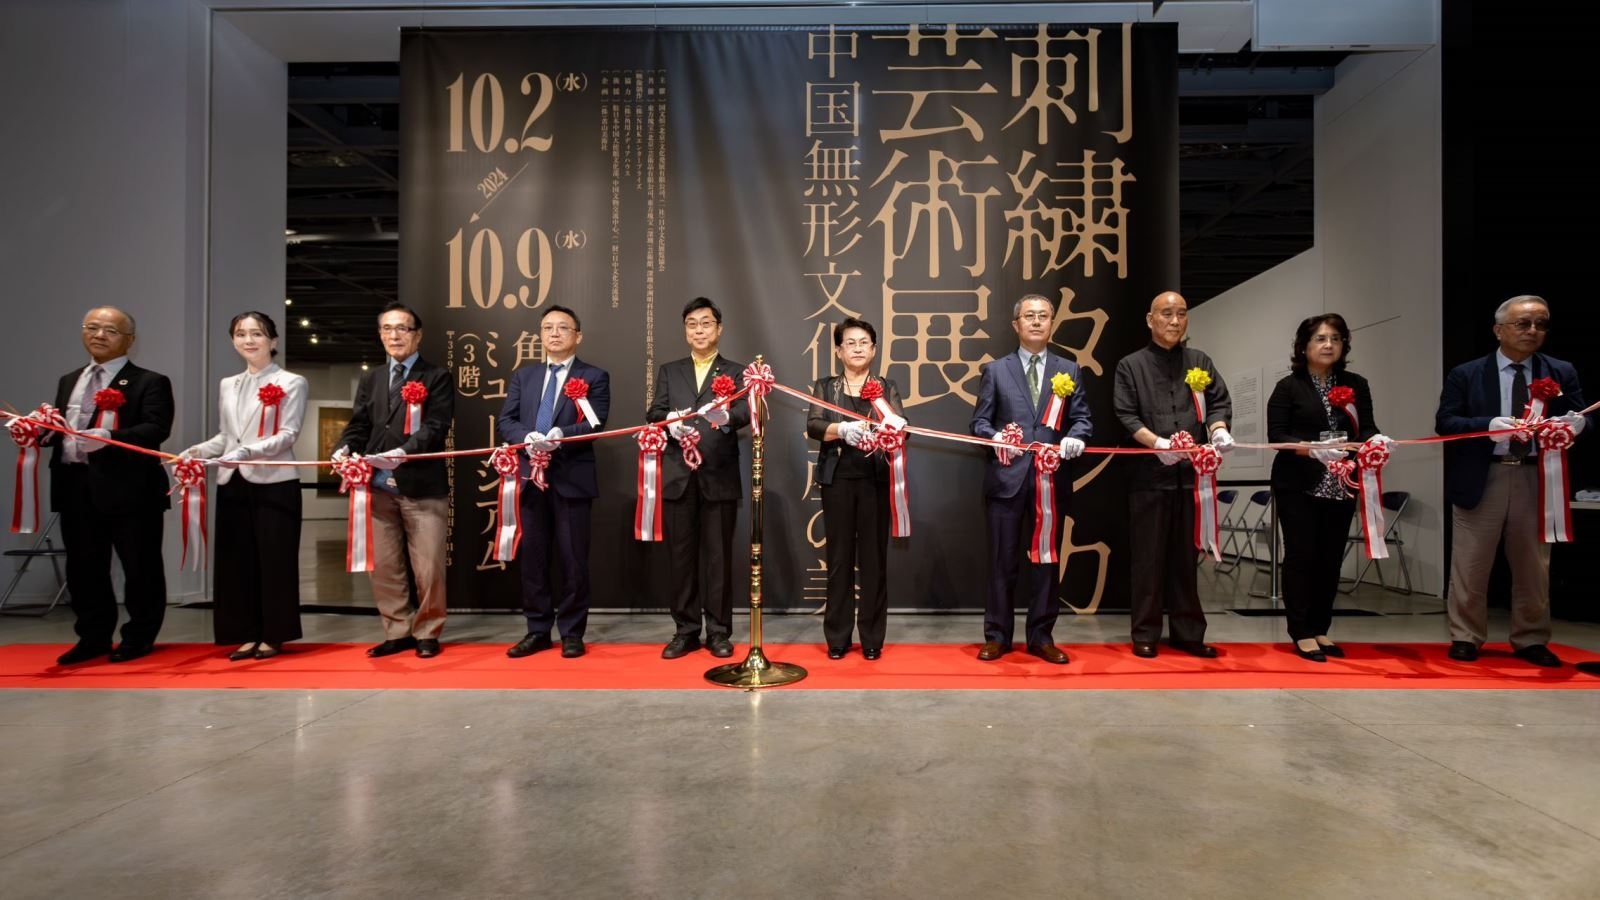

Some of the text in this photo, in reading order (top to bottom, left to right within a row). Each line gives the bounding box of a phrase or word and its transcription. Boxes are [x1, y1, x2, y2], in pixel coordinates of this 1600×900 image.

[446, 72, 588, 153] 10.2 (水)
[476, 167, 509, 200] 2024
[867, 23, 1002, 408] 芸術展
[445, 228, 587, 309] 10.9 (水)
